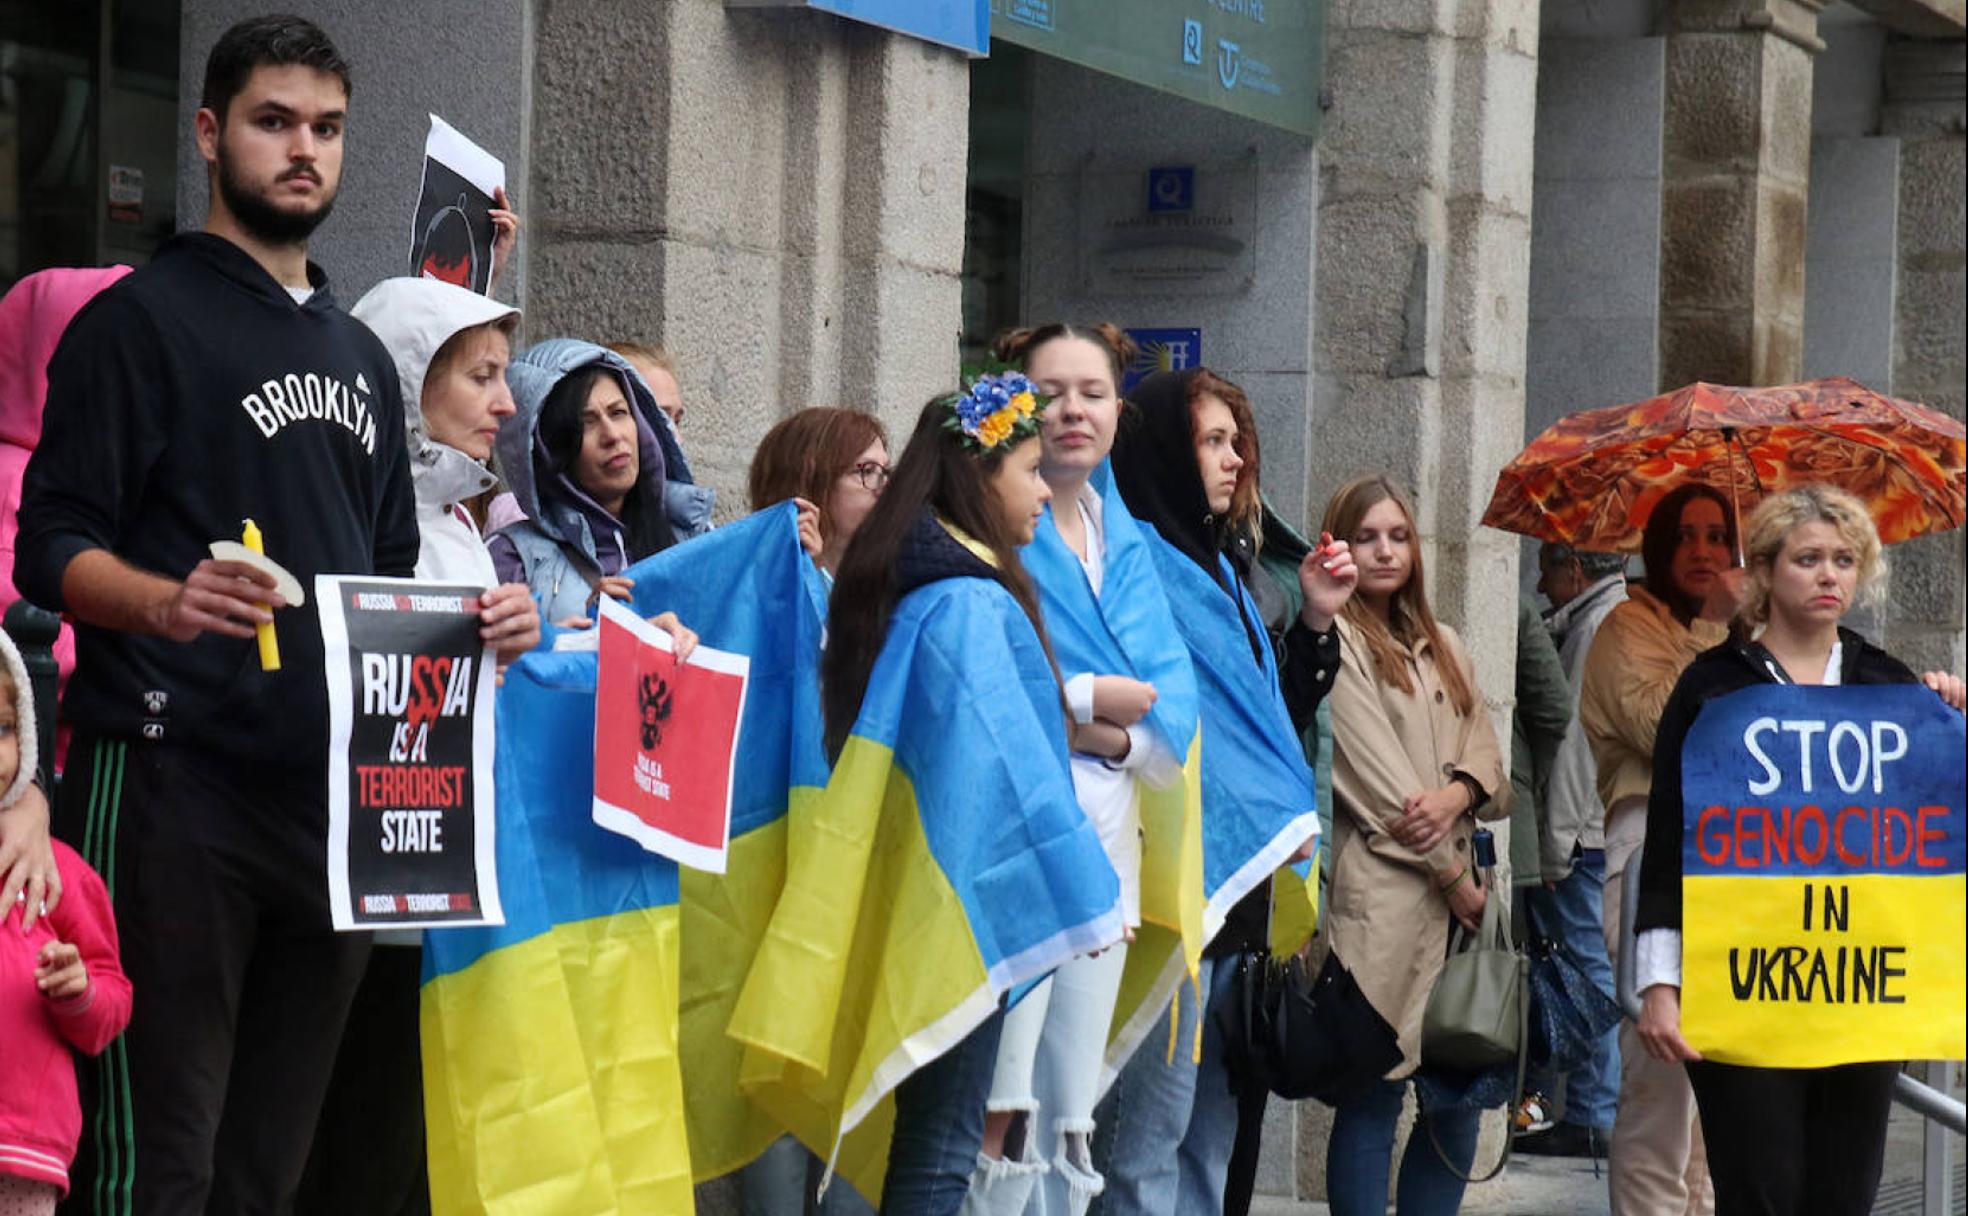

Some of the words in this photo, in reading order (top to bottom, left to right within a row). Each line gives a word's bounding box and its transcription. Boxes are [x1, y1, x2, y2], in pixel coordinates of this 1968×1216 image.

[241, 372, 377, 456] BROOKLYN
[362, 653, 472, 719] RUSSIA
[411, 721, 428, 763] A
[1743, 716, 1908, 795] STOP
[356, 765, 465, 807] TERRORIST
[380, 810, 443, 854] STATE
[1696, 804, 1949, 868] GENOCIDE
[1804, 884, 1848, 931] IN
[1729, 946, 1906, 1004] UKRAINE
